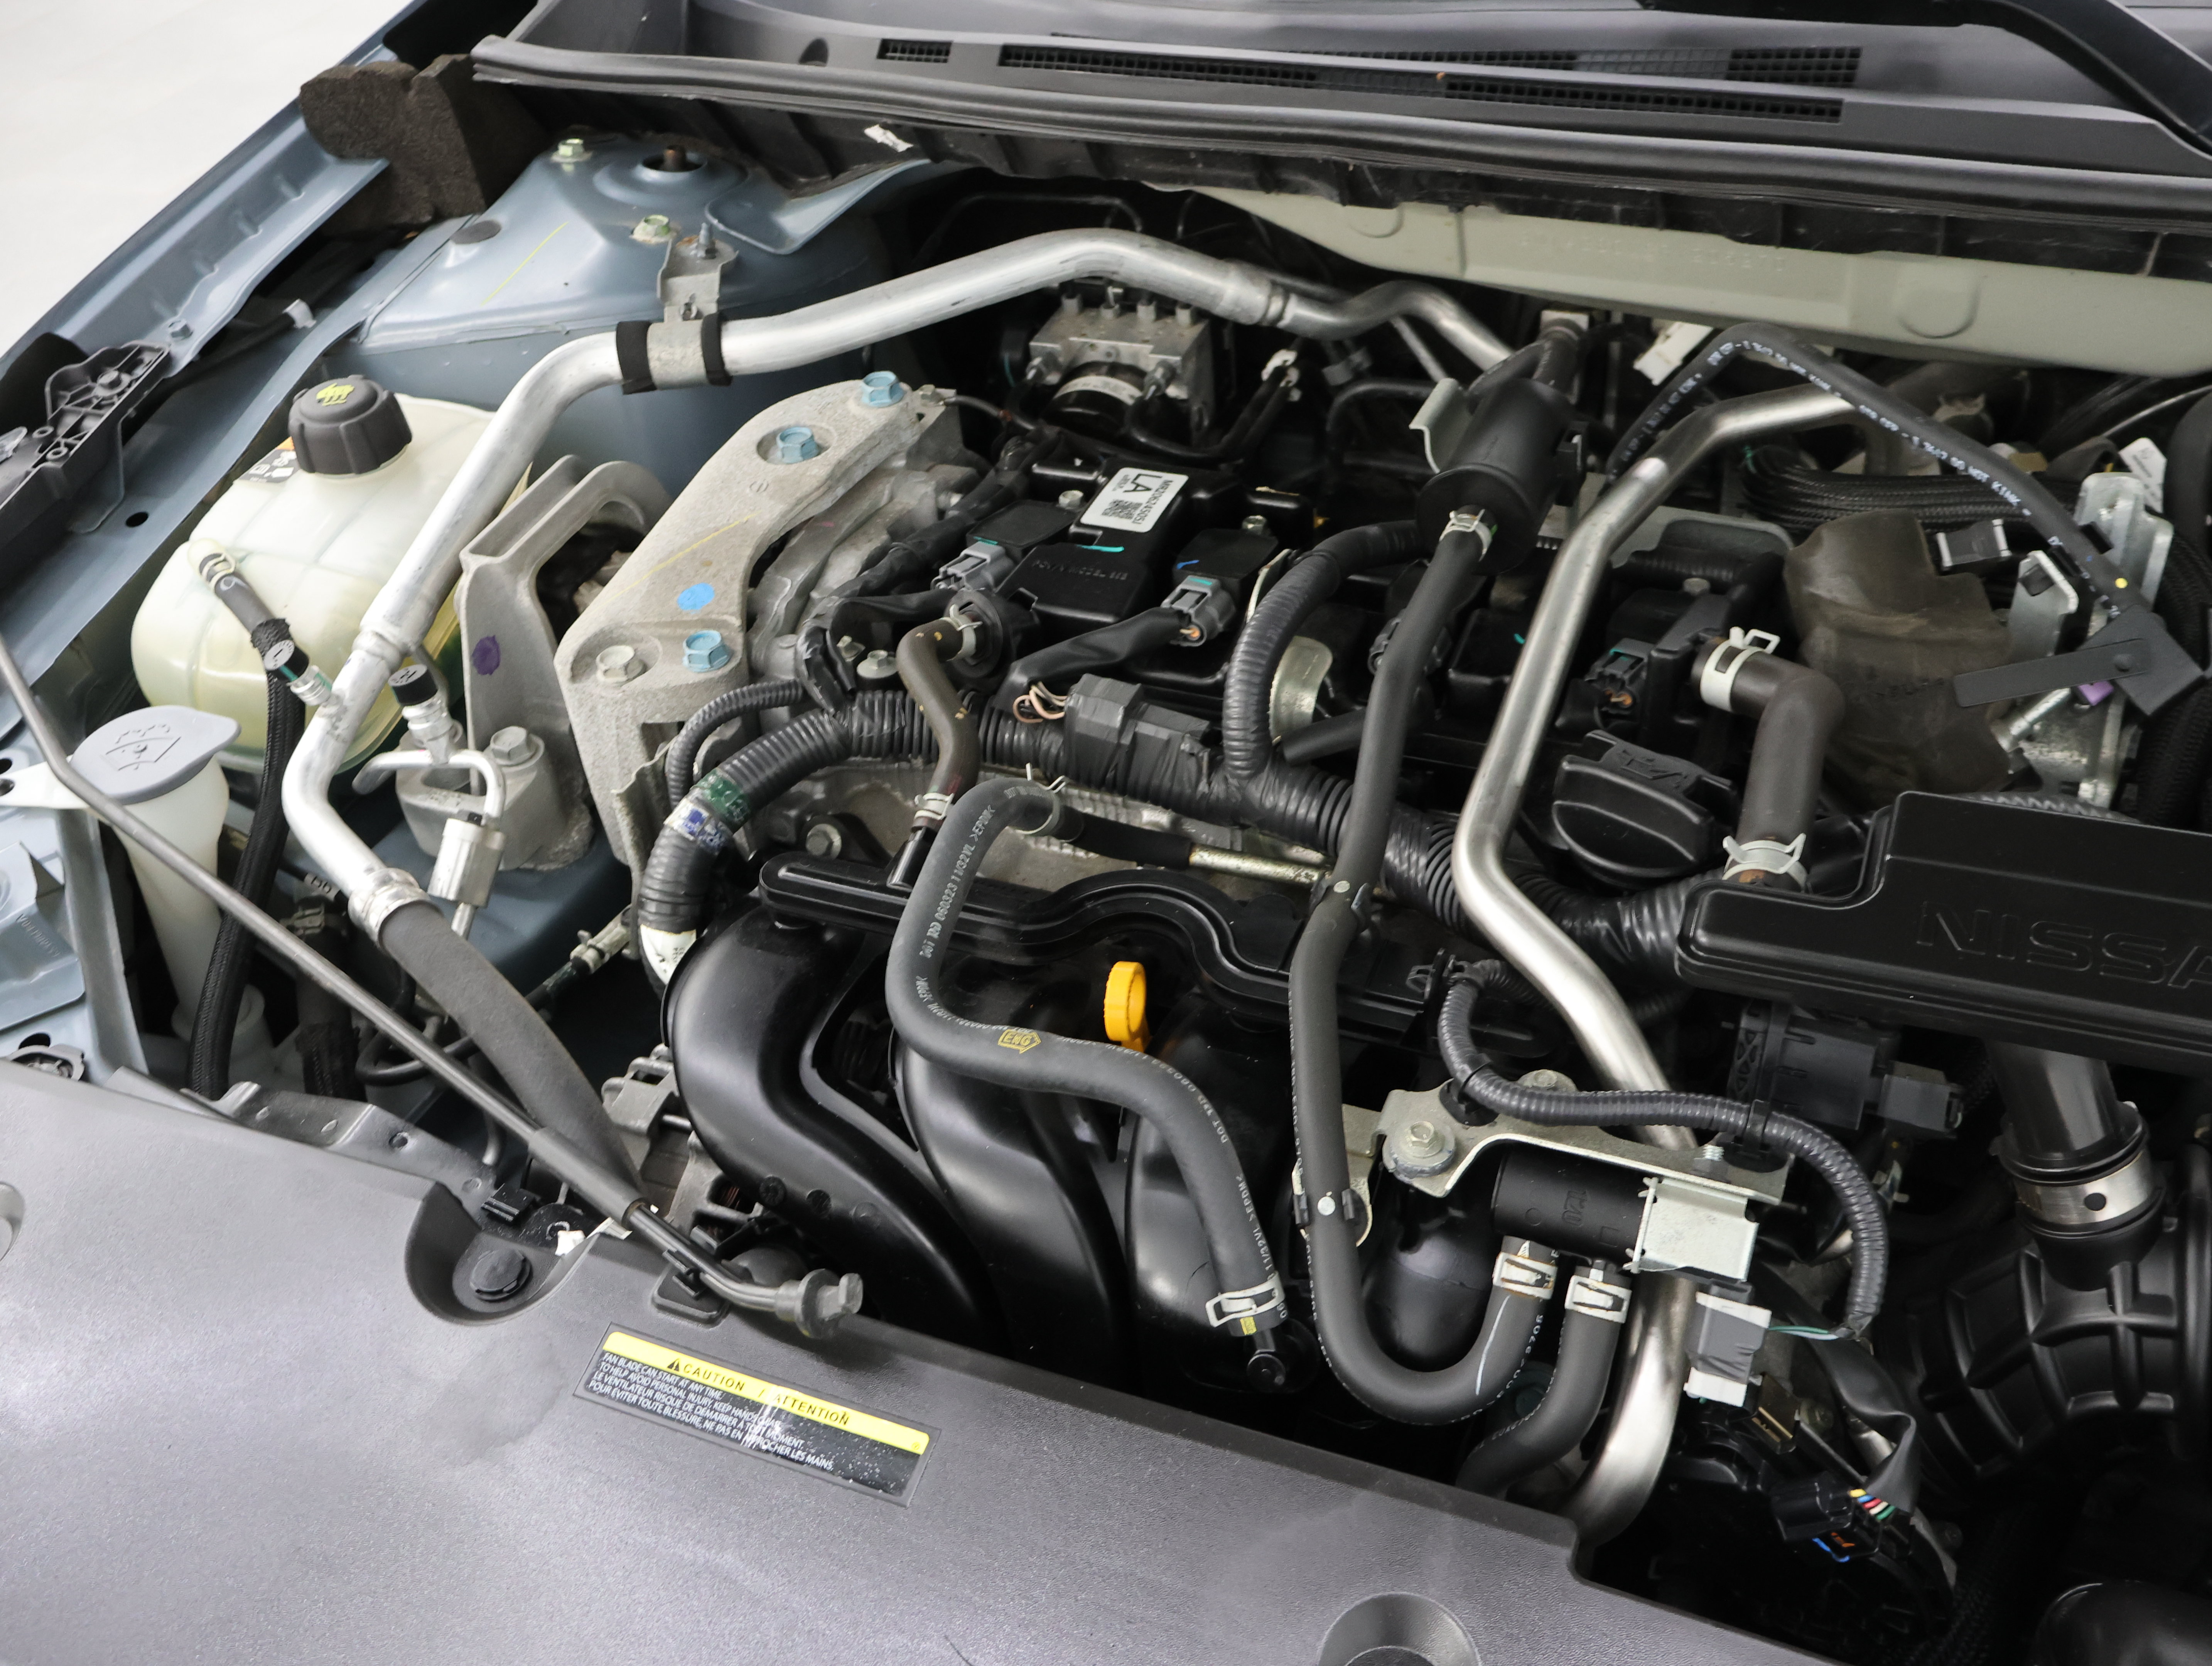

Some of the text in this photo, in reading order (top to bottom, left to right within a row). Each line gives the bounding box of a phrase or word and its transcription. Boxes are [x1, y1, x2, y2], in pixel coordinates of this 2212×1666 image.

[1123, 474, 1163, 493] LA
[1003, 1032, 1034, 1046] ENG
[592, 1370, 605, 1381] LE
[601, 1373, 655, 1399] VENTILATEUR
[652, 1391, 684, 1409] RISQUE
[681, 1401, 695, 1413] DE
[597, 1361, 612, 1373] TO
[608, 1365, 630, 1379] HELP
[626, 1371, 652, 1387] AVOID
[649, 1379, 689, 1400] PERSONAL
[712, 1400, 733, 1415] KEEP
[602, 1352, 619, 1364] FAN
[616, 1357, 643, 1373] BLADE
[639, 1365, 658, 1378] CAN
[655, 1370, 680, 1386] START
[677, 1378, 690, 1389] AT
[687, 1381, 706, 1394] ANY
[682, 1363, 746, 1391] CAUTION
[773, 1393, 850, 1426] ATTENTION
[587, 1379, 613, 1395] POUR
[635, 1396, 666, 1414] TOUTE
[702, 1419, 717, 1431] NE
[714, 1423, 732, 1437] PAS
[729, 1428, 744, 1441] EN
[790, 1448, 807, 1462] LES
